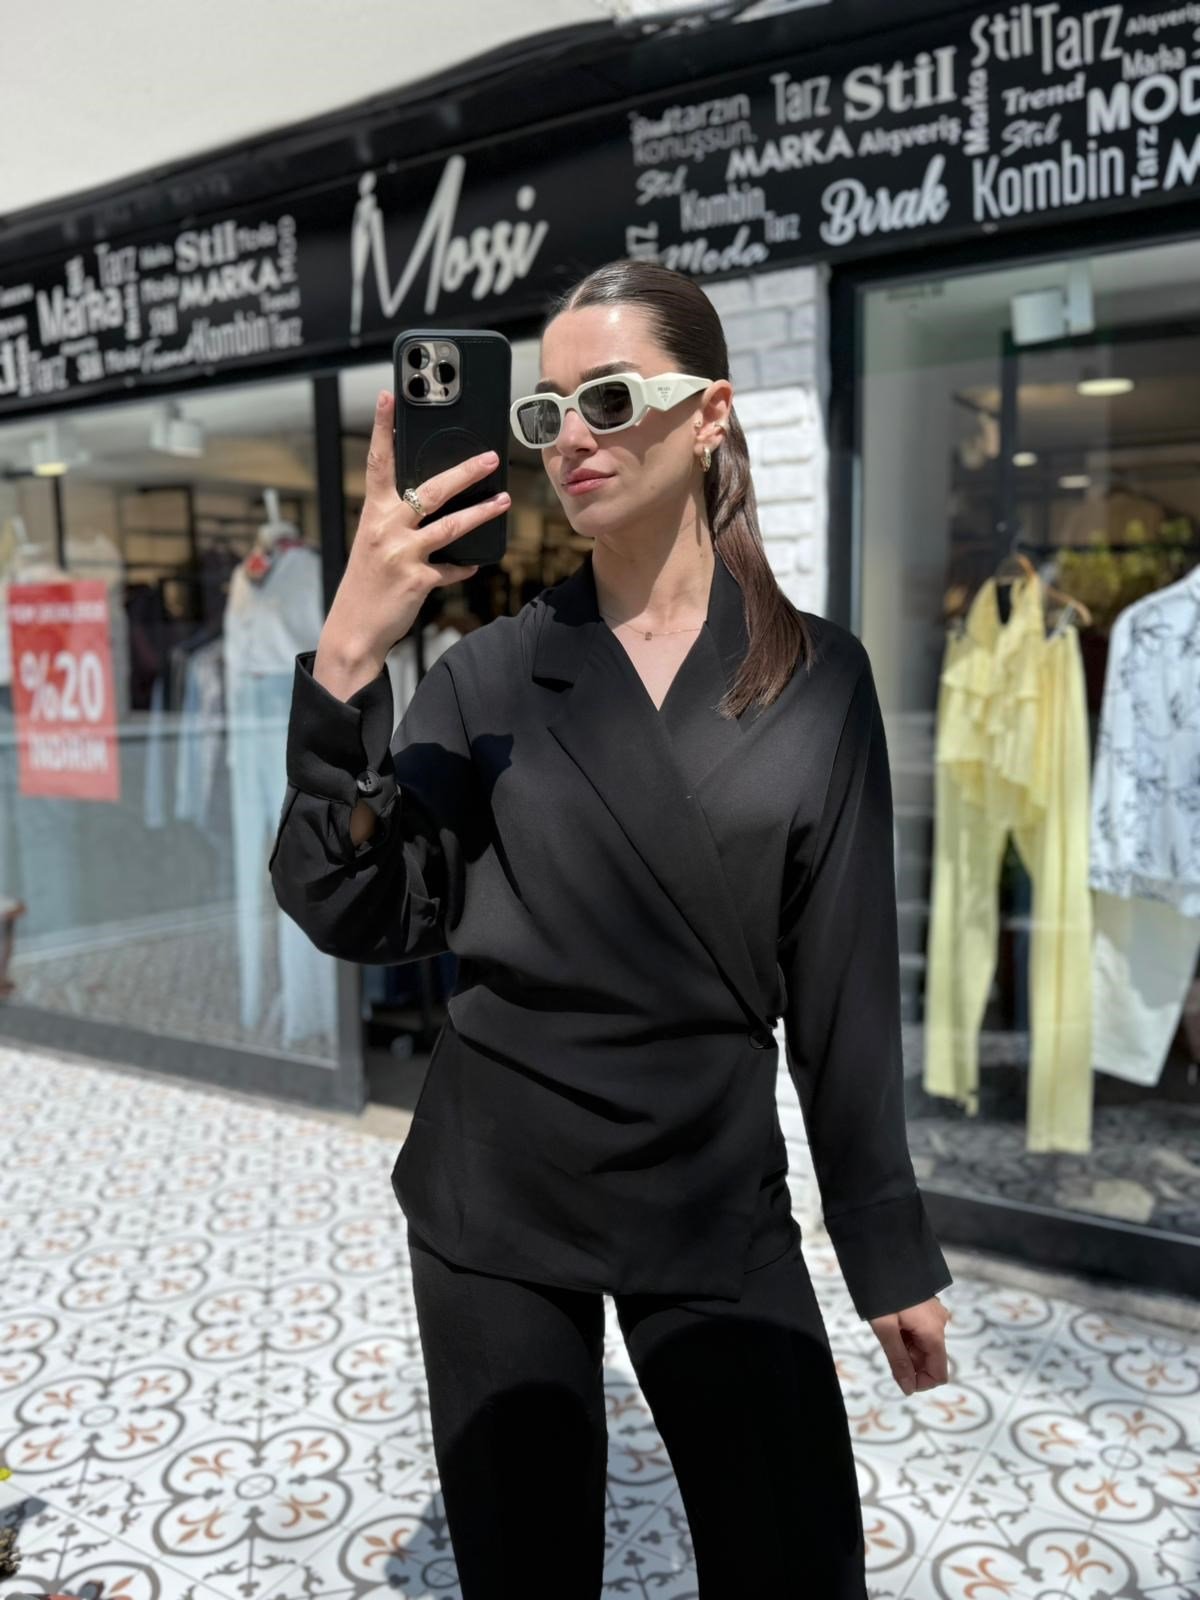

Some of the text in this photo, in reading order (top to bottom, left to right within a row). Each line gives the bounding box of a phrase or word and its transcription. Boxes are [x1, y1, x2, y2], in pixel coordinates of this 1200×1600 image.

[970, 3, 1034, 68] Stil
[1032, 4, 1123, 76] Tarz
[769, 45, 957, 125] Tarz Stil
[1001, 72, 1086, 116] Trend
[725, 125, 855, 182] MARKA
[1001, 112, 1062, 157] Stil
[1131, 124, 1159, 198] Tarz
[972, 138, 1125, 223] Kombin
[351, 154, 549, 334] Mossi
[178, 256, 282, 312] MARKA
[20, 651, 106, 722] %20
